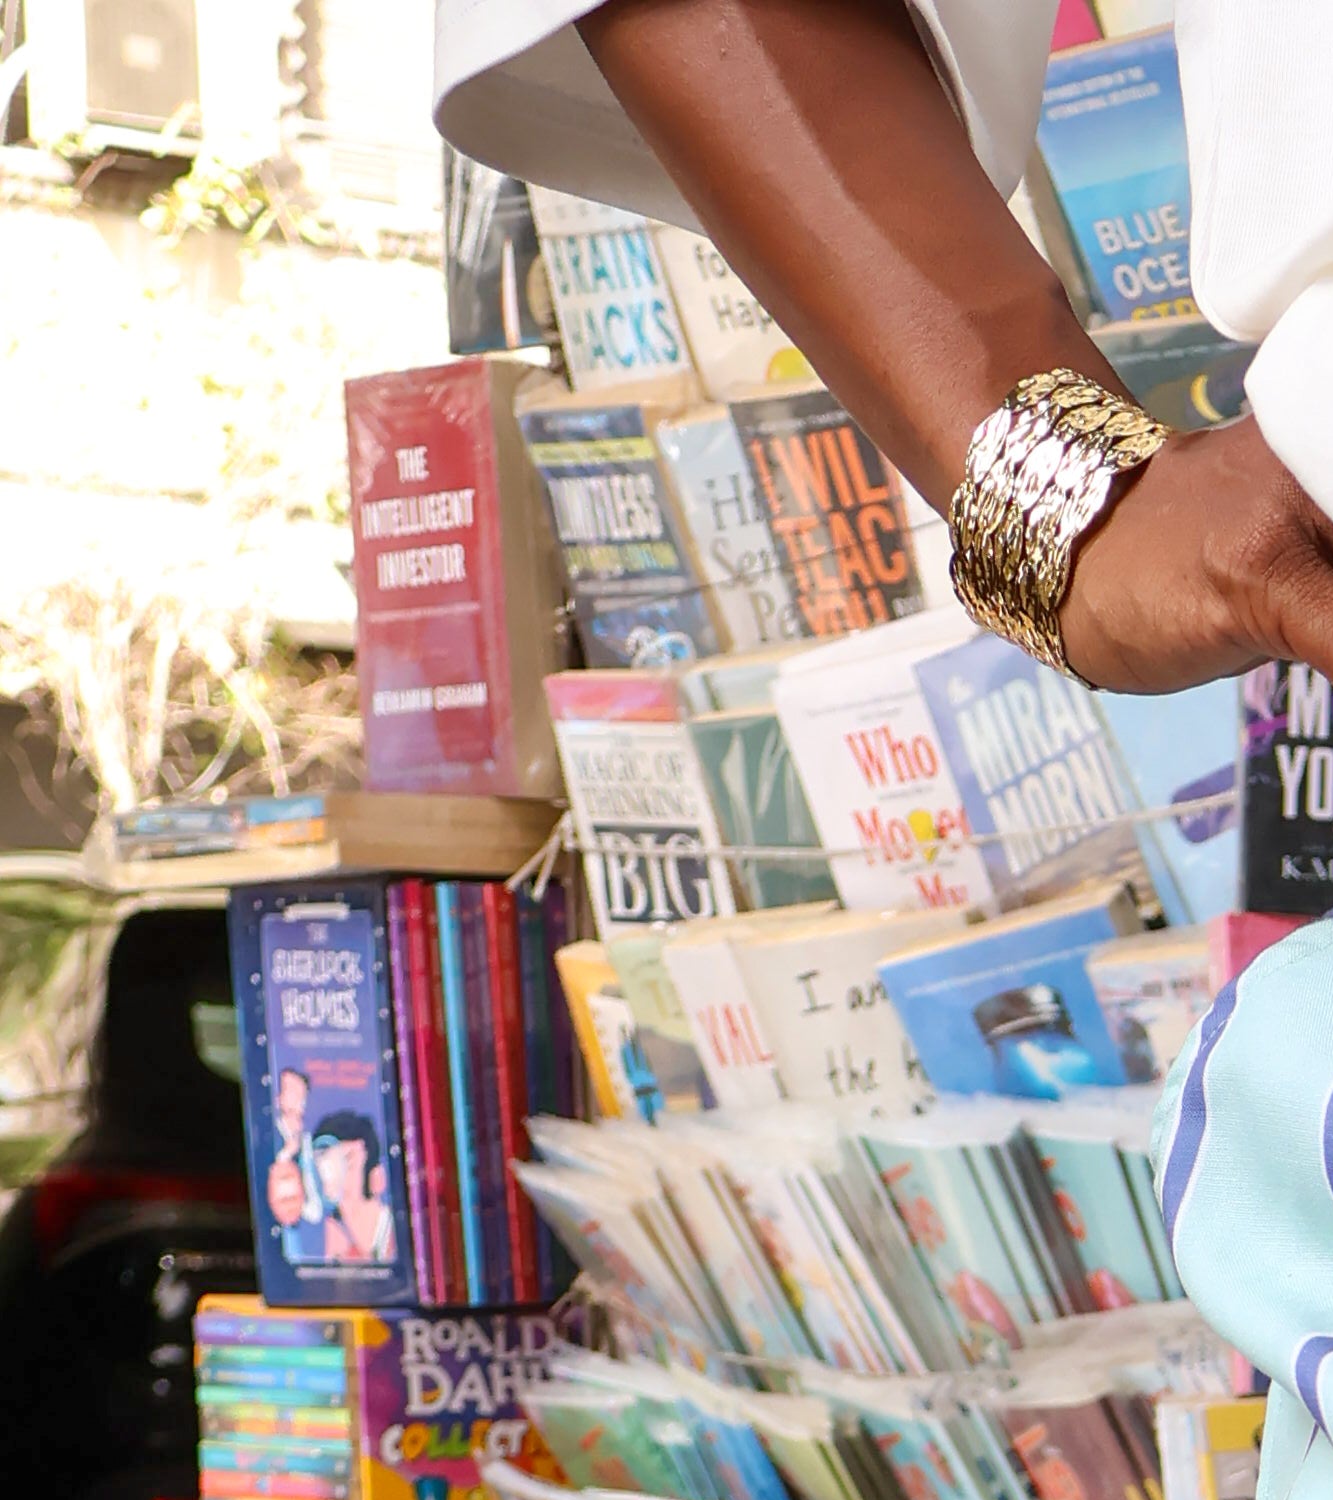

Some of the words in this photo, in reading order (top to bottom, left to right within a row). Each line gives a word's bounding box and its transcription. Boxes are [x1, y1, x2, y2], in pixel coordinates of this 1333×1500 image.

[1093, 203, 1189, 255] BLUE
[553, 233, 660, 298] BRAIN
[568, 298, 682, 375] HACKS
[396, 445, 429, 483] THE
[361, 488, 476, 540] INTELLIGENT
[376, 543, 467, 591] INVESTOR
[843, 723, 940, 790] Who
[600, 831, 714, 920] BIG
[271, 948, 365, 986] SHERLOCK
[281, 987, 360, 1031] HOLMES
[825, 1044, 881, 1098] the
[399, 1315, 560, 1362] ROALD
